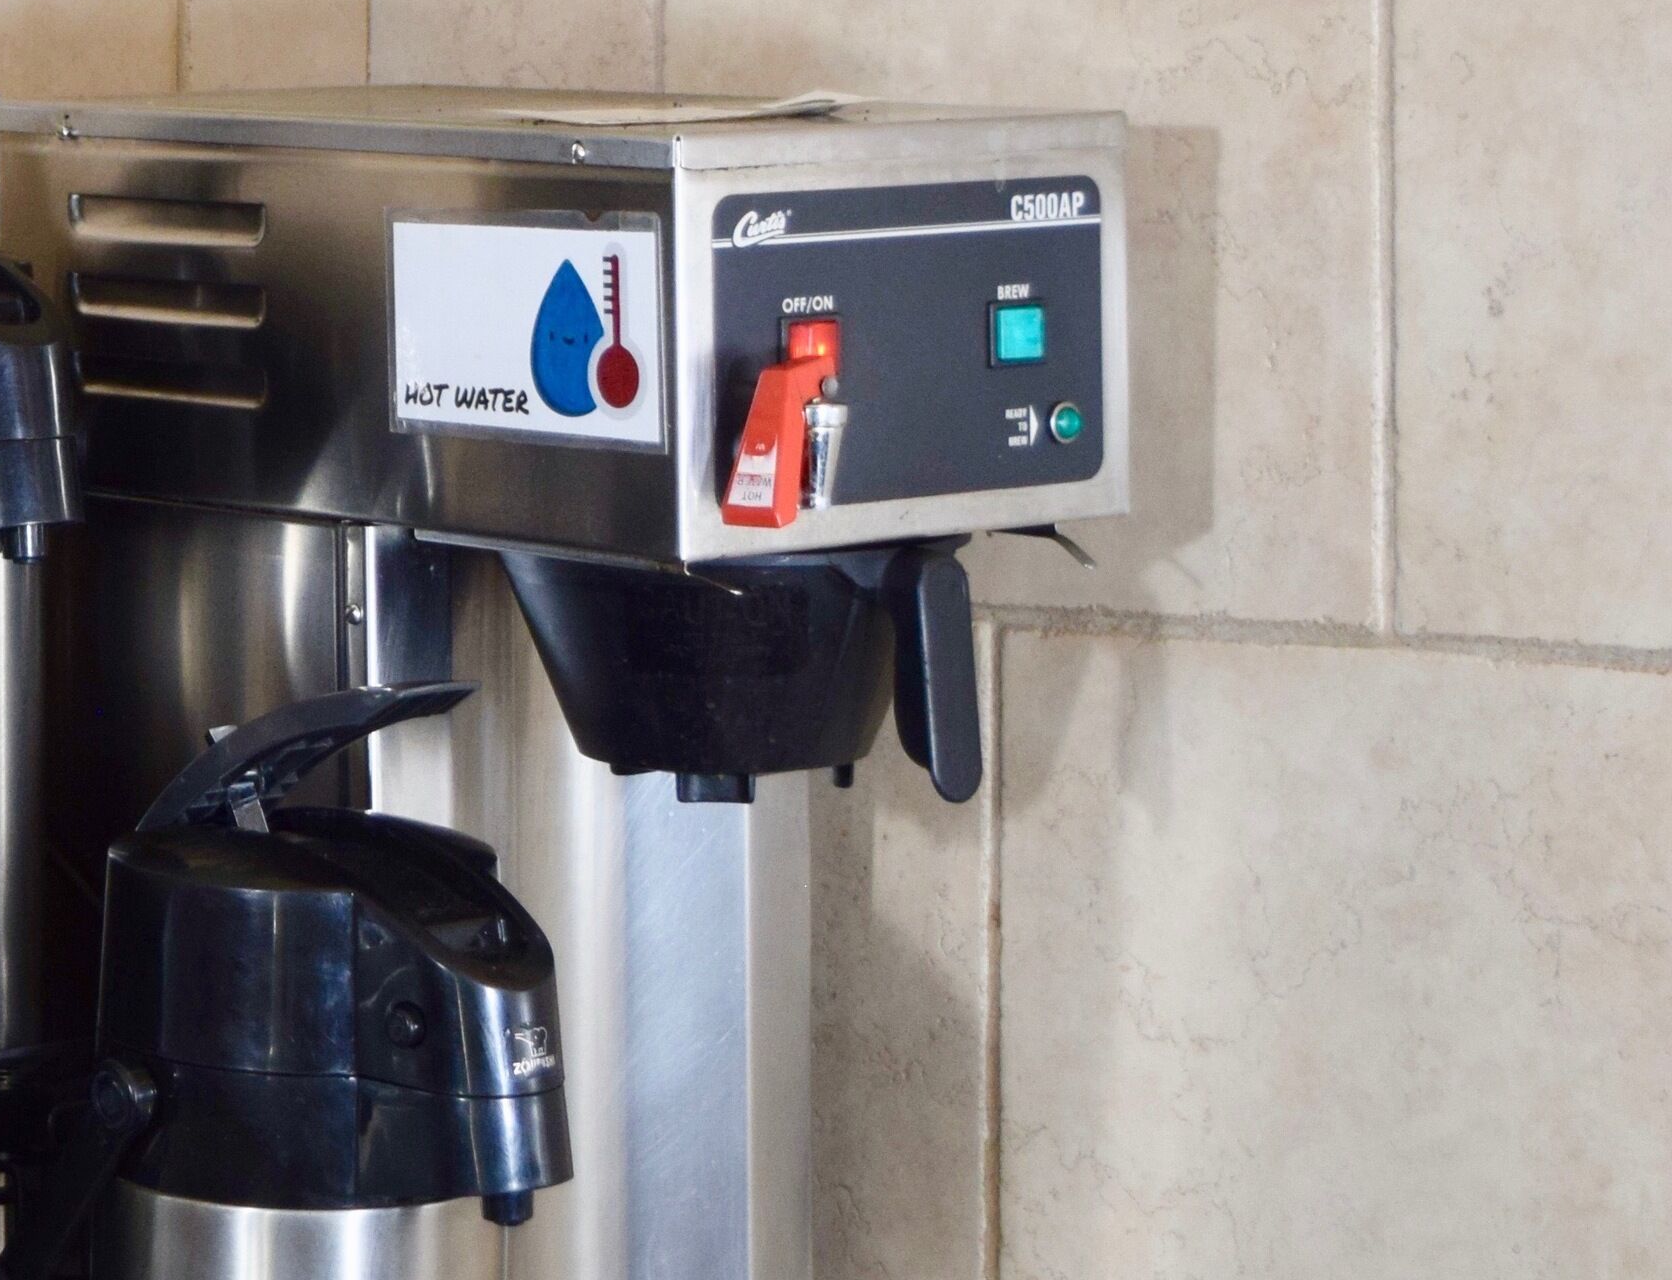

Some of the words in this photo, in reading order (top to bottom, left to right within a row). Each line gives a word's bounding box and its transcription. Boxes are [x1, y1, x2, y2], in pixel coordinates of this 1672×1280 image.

[1010, 191, 1085, 221] C500AP
[732, 210, 786, 247] Curtis
[782, 295, 834, 313] OFF/ON
[997, 284, 1030, 300] BREW
[405, 382, 449, 407] HOT
[454, 385, 530, 415] WATER
